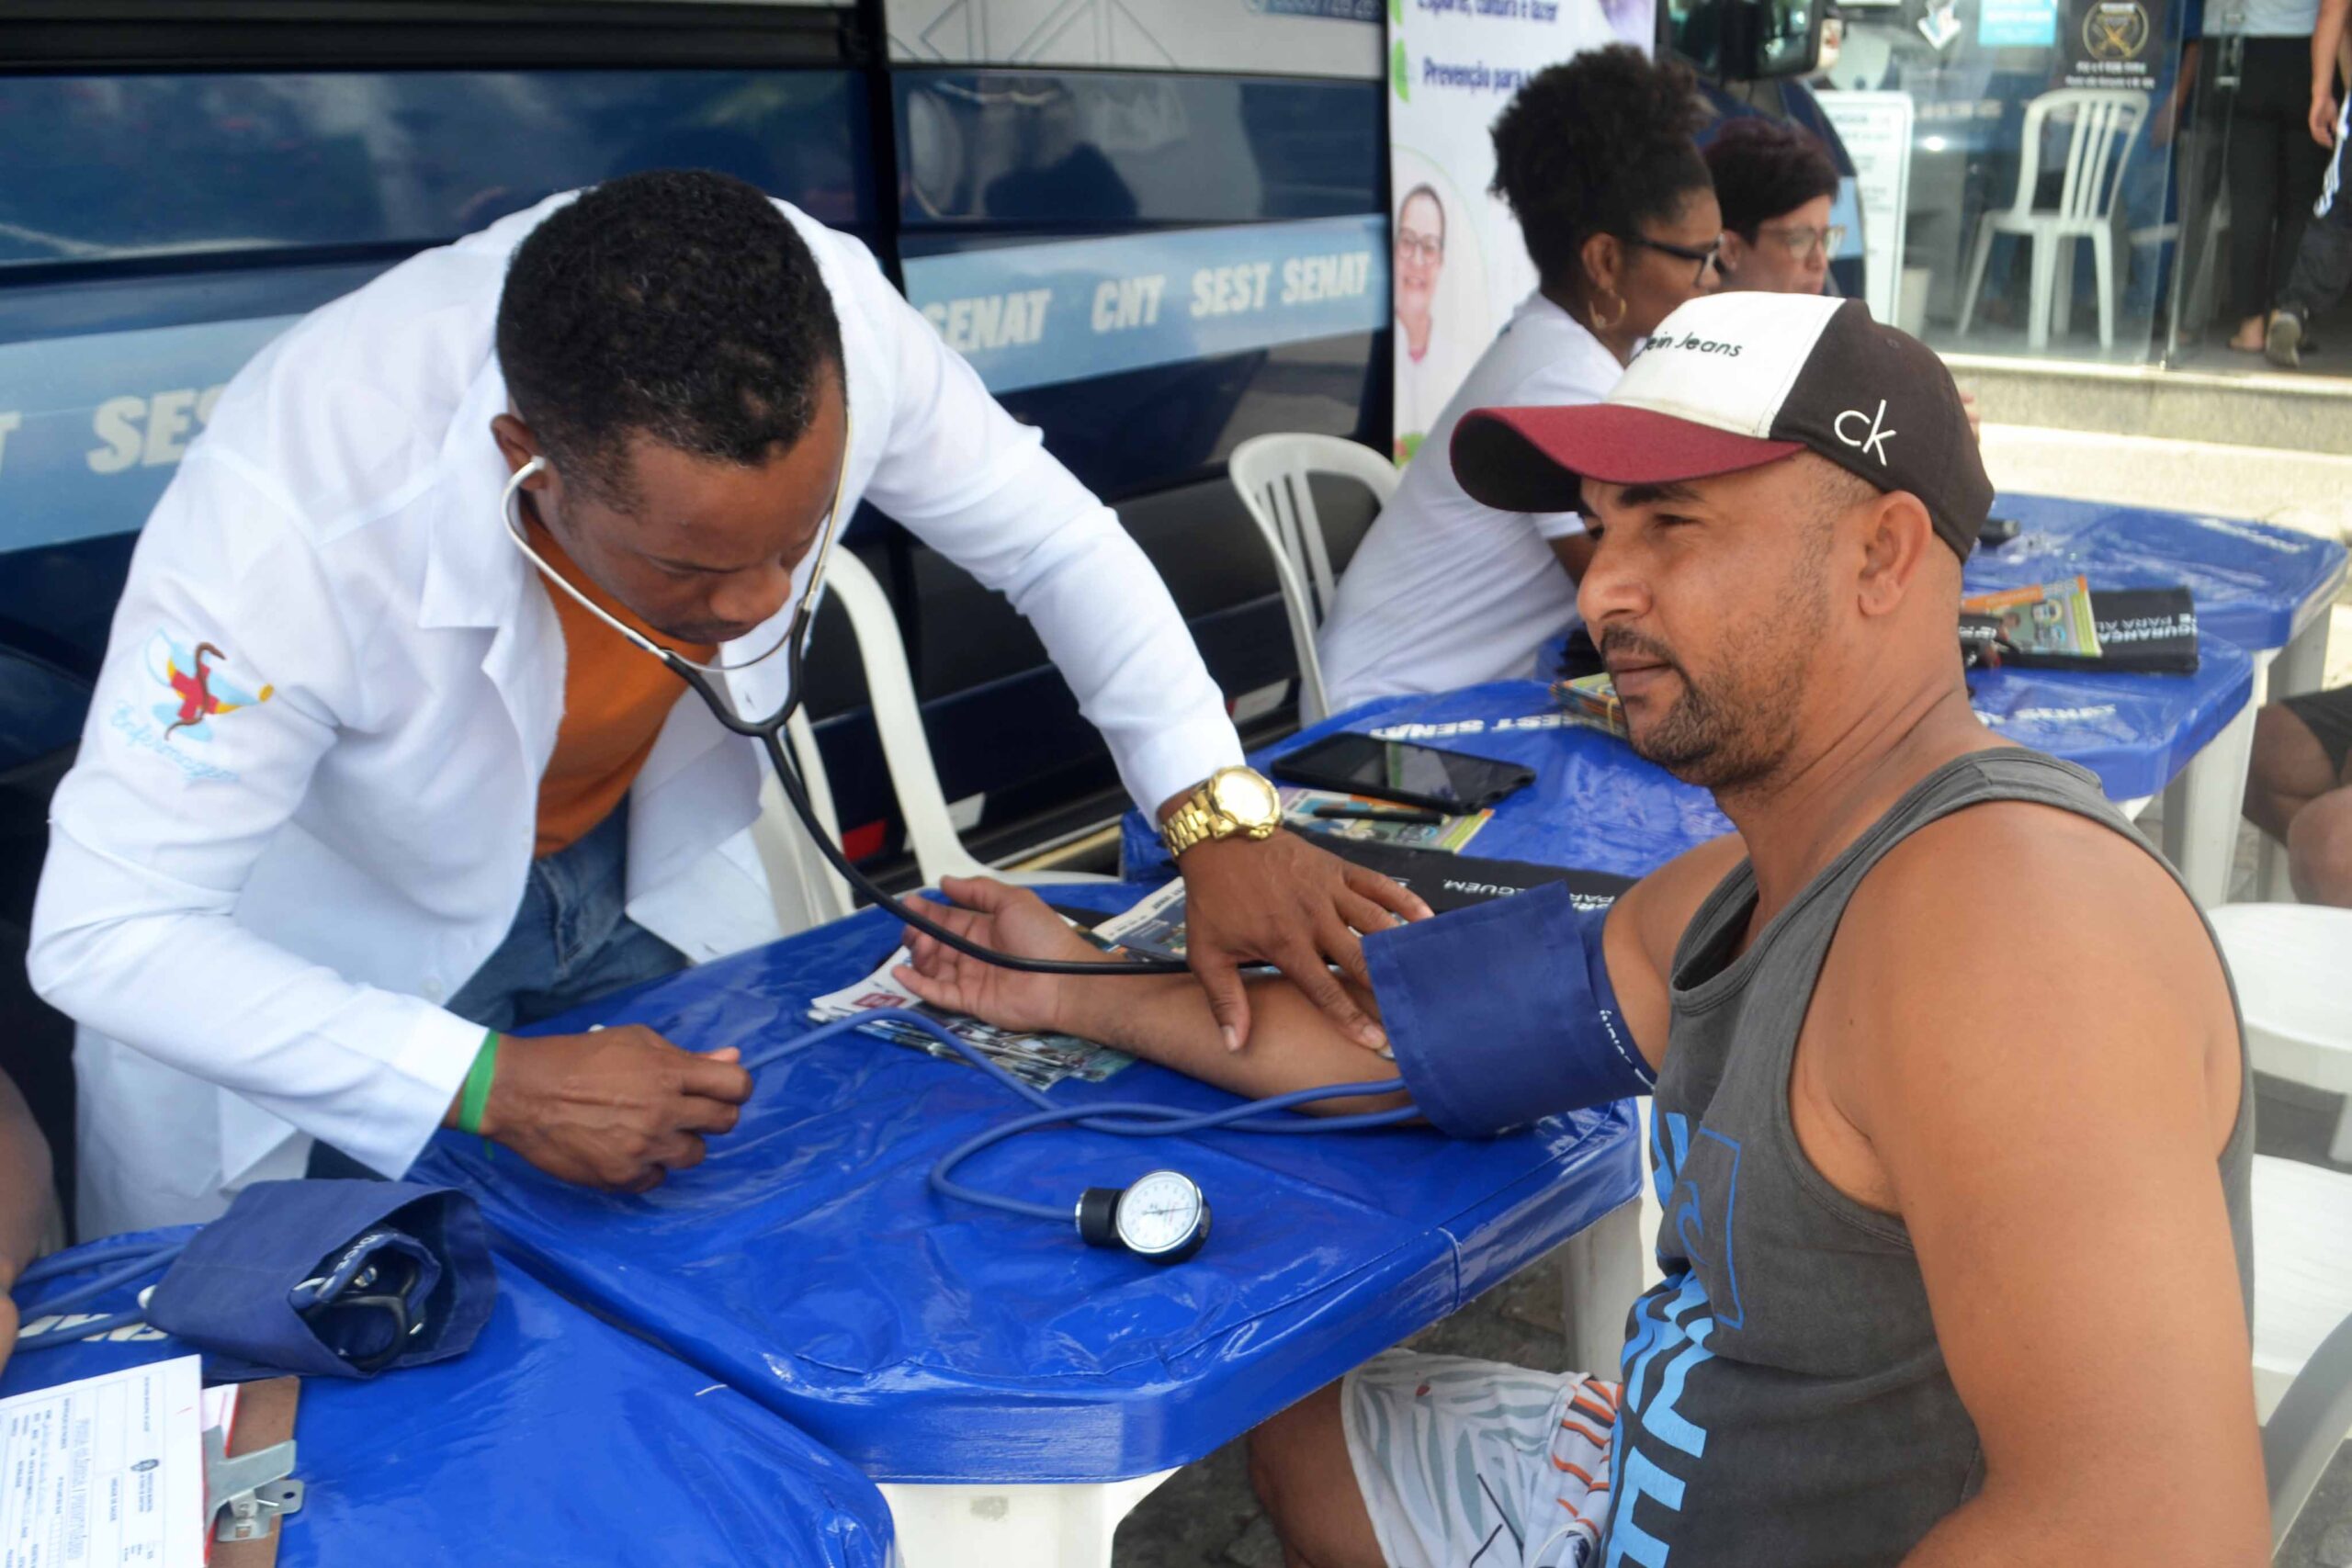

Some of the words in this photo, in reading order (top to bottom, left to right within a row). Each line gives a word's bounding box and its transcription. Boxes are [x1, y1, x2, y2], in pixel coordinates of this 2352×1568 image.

[1424, 56, 1489, 95] Prevenção
[921, 289, 1052, 354] SENAT
[1091, 276, 1164, 333] CNT
[1191, 263, 1272, 317] SEST
[1282, 252, 1371, 304] SENAT
[1674, 332, 1743, 357] Jeans
[1442, 879, 1526, 897] GUÉM.
